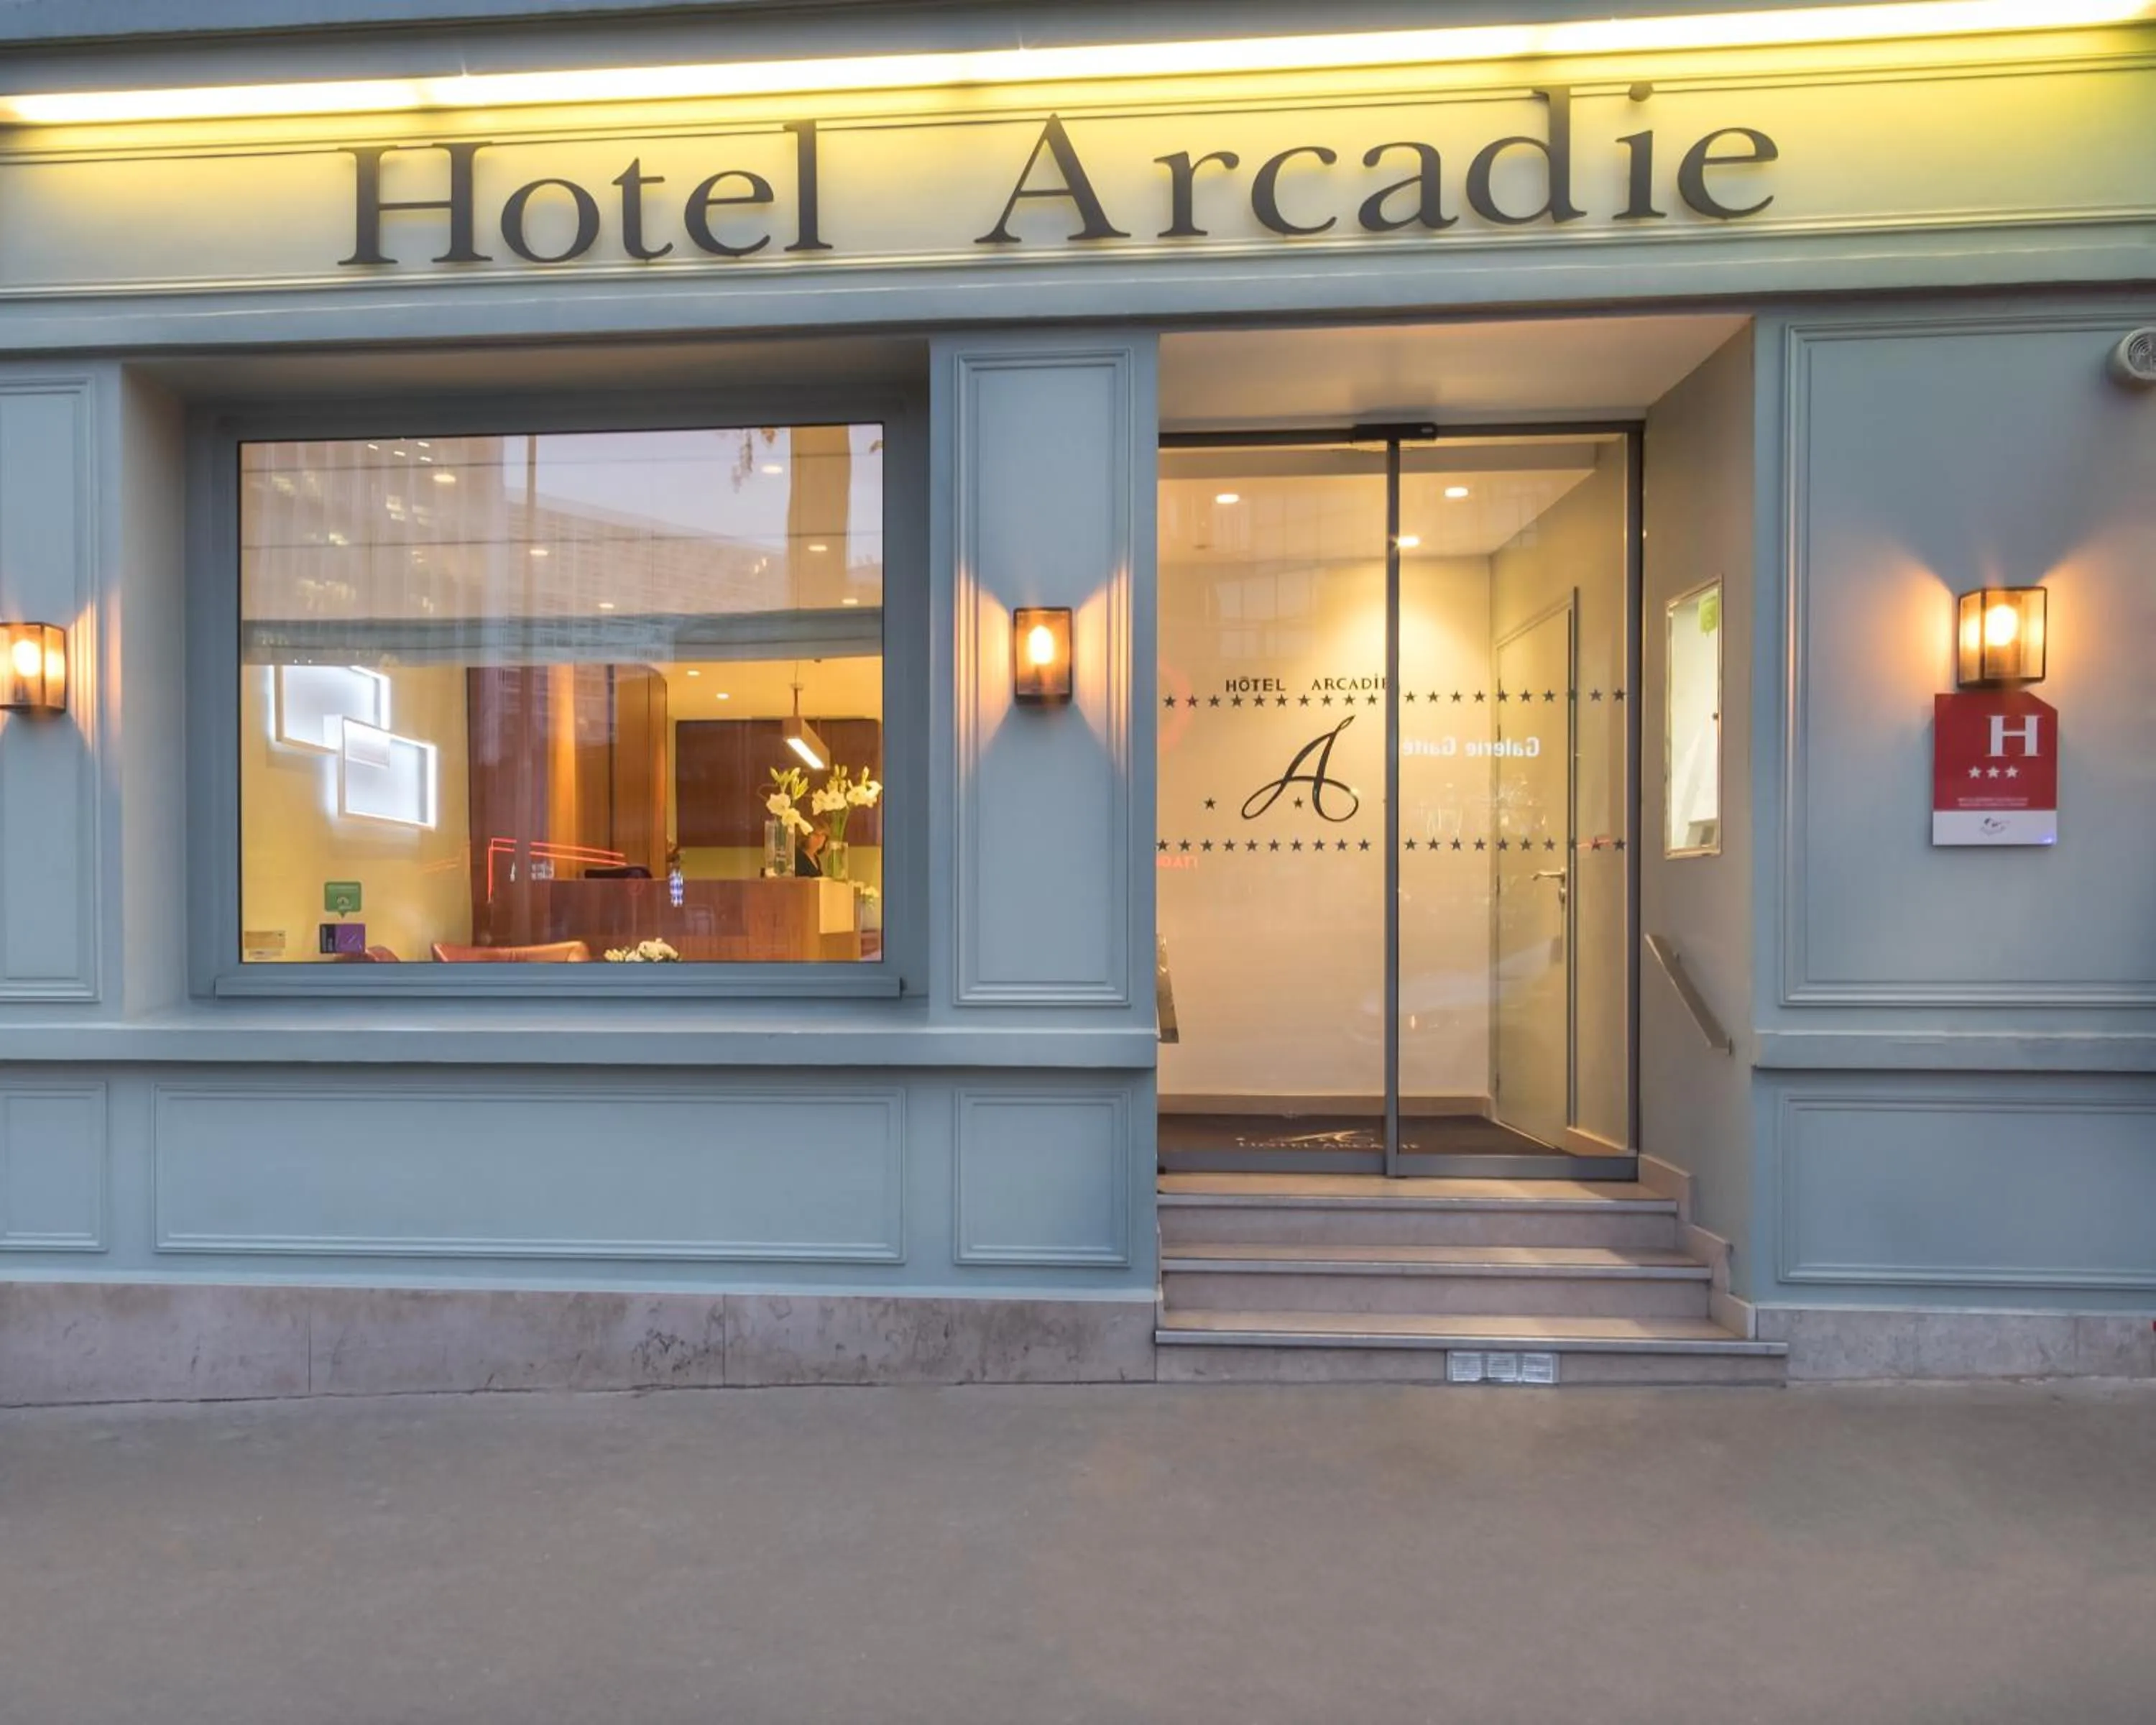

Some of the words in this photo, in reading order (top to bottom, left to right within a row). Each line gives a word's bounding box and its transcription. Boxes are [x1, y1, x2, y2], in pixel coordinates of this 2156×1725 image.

[337, 119, 834, 266] Hotel
[975, 84, 1779, 244] Arcadie
[1225, 676, 1286, 692] HÔTEL
[1985, 715, 2043, 756] H
